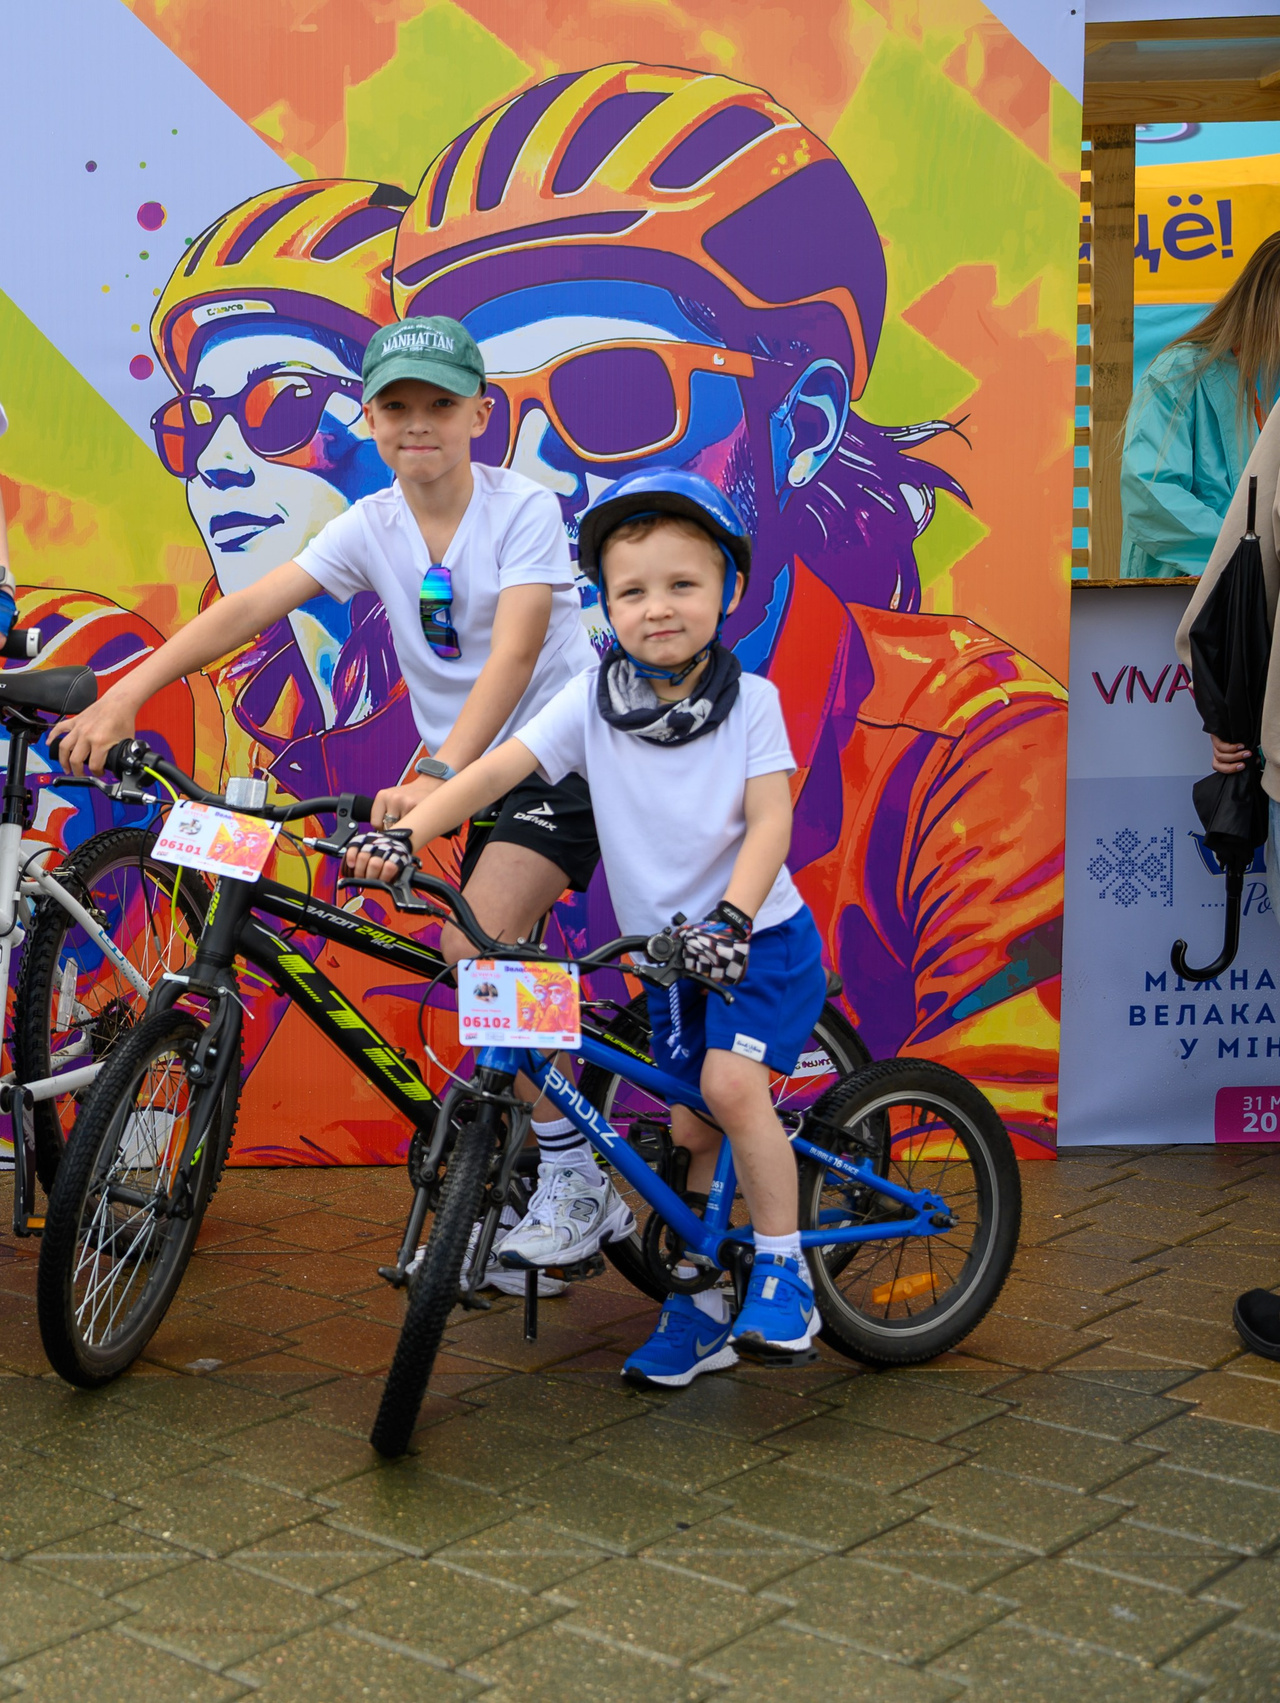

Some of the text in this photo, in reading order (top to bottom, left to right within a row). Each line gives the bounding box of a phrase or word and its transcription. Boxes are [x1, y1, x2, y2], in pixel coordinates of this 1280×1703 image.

[382, 331, 455, 354] MANHATTAN
[1092, 664, 1196, 704] VIVA
[513, 811, 558, 832] DEMIX
[160, 838, 201, 855] 06101
[306, 905, 394, 945] BANDIT 240
[463, 1016, 511, 1028] 06102
[1129, 1003, 1277, 1026] ВЕЛАКА
[603, 1033, 653, 1064] SUPERLITE
[1179, 1037, 1280, 1060] У МІН
[544, 1065, 620, 1149] SHULZ
[1243, 1096, 1262, 1111] 31
[1243, 1112, 1278, 1132] 20
[809, 1146, 859, 1176] BUBBLE 16 RACE
